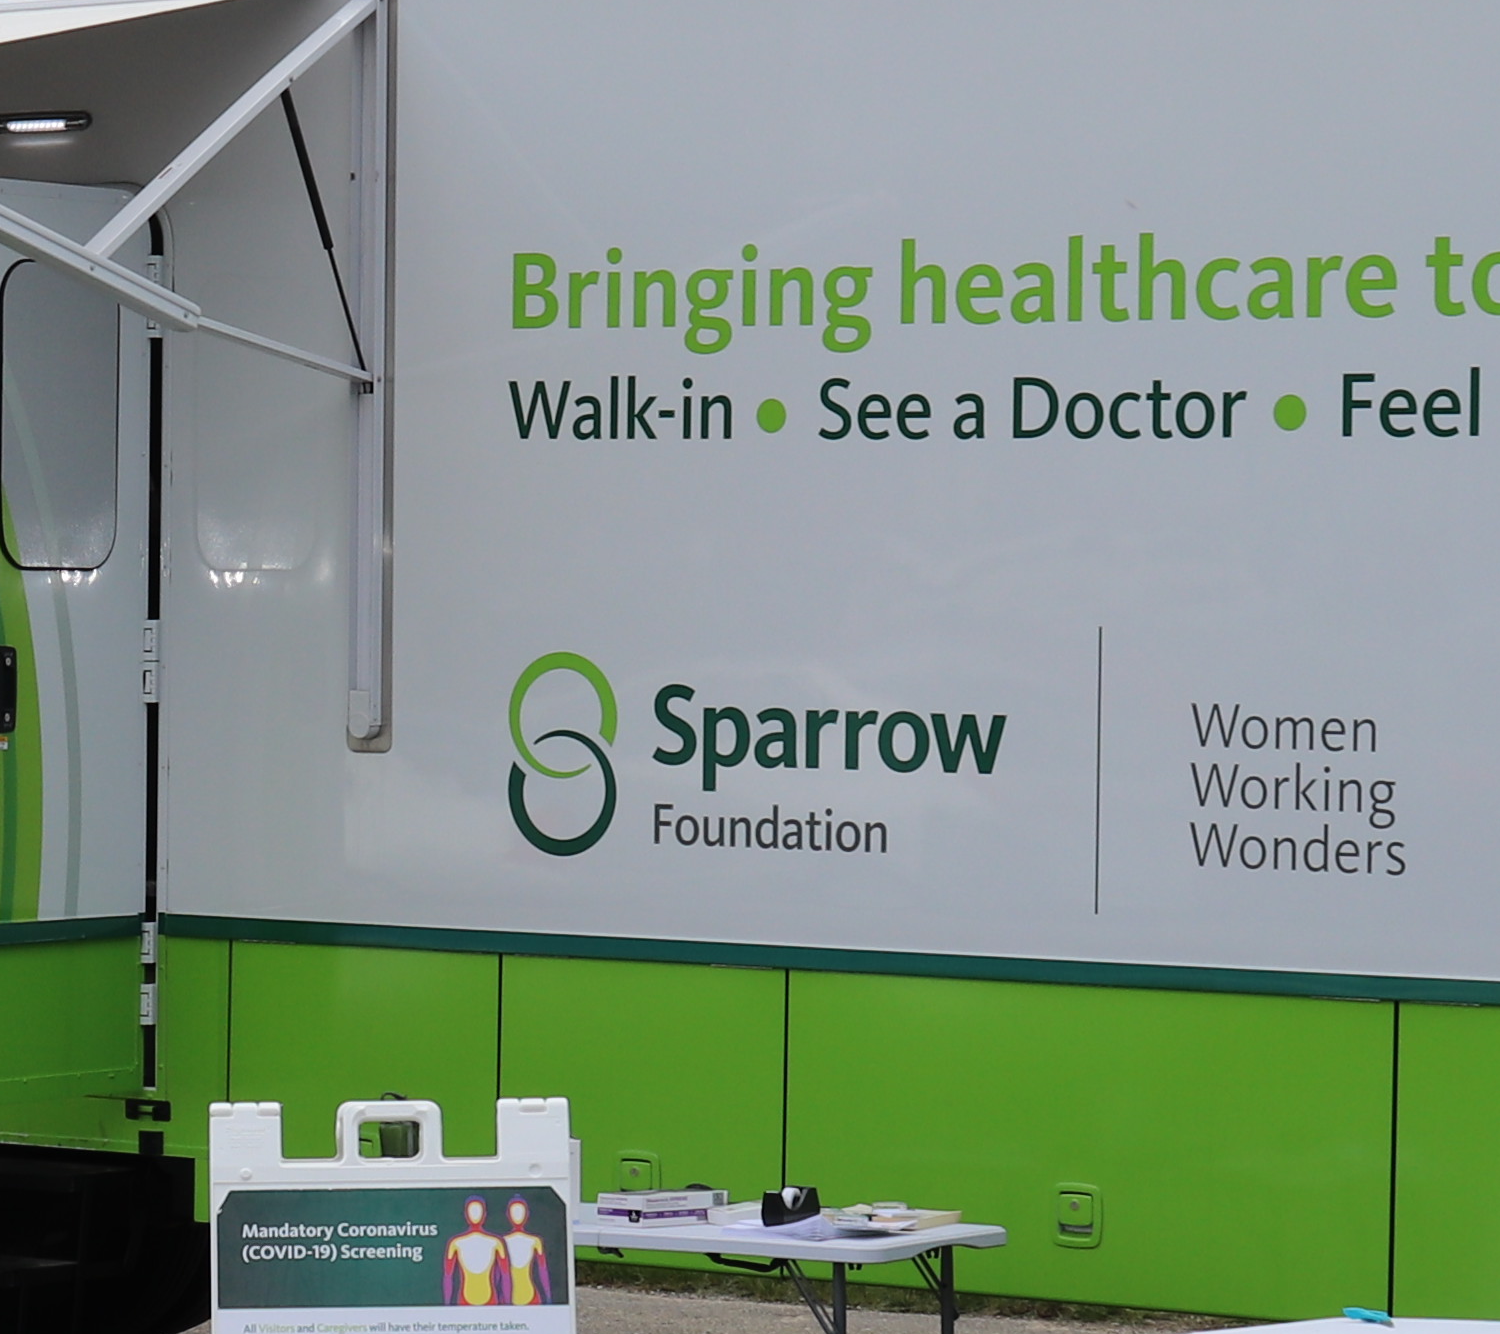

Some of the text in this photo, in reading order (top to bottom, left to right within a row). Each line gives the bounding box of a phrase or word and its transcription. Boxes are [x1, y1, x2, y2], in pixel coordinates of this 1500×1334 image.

[512, 244, 873, 355] Bringing
[900, 233, 1398, 325] healthcare
[508, 375, 732, 440] Walk-in
[818, 378, 931, 440] See
[953, 393, 985, 440] a
[1012, 377, 1248, 439] Doctor
[1342, 367, 1480, 438] Feel
[652, 684, 1007, 792] Sparrow
[1191, 703, 1376, 752] Women
[1190, 763, 1397, 829] Working
[654, 803, 887, 853] Foundation
[1190, 823, 1406, 877] Wonders
[242, 1222, 438, 1241] Mandatory Coronavirus
[242, 1243, 423, 1263] (COVID-19) Screening
[243, 1321, 529, 1334] All Visitors and Caregivers will have their temperature taken.
